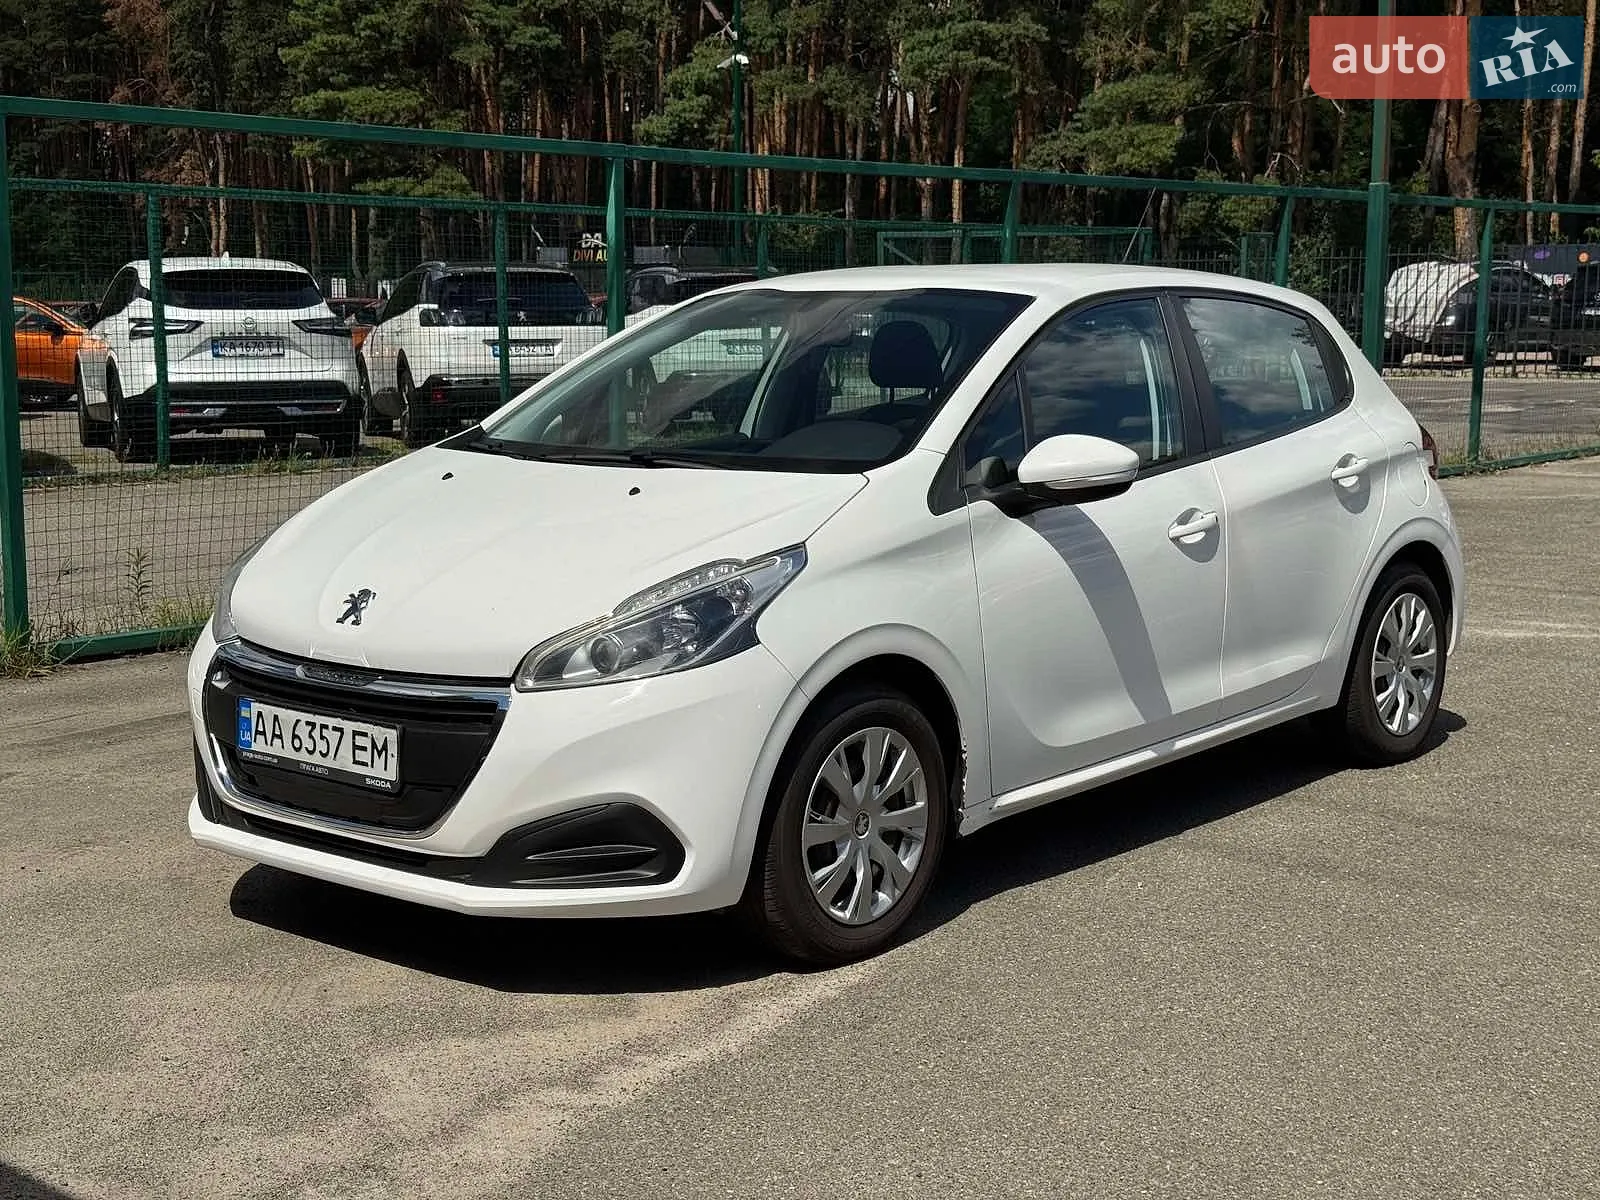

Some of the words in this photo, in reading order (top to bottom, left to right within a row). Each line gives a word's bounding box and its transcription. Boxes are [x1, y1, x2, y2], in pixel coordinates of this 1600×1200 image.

[240, 731, 252, 742] UA
[254, 710, 285, 750] AA
[291, 719, 345, 761] 6357
[352, 729, 389, 771] EM
